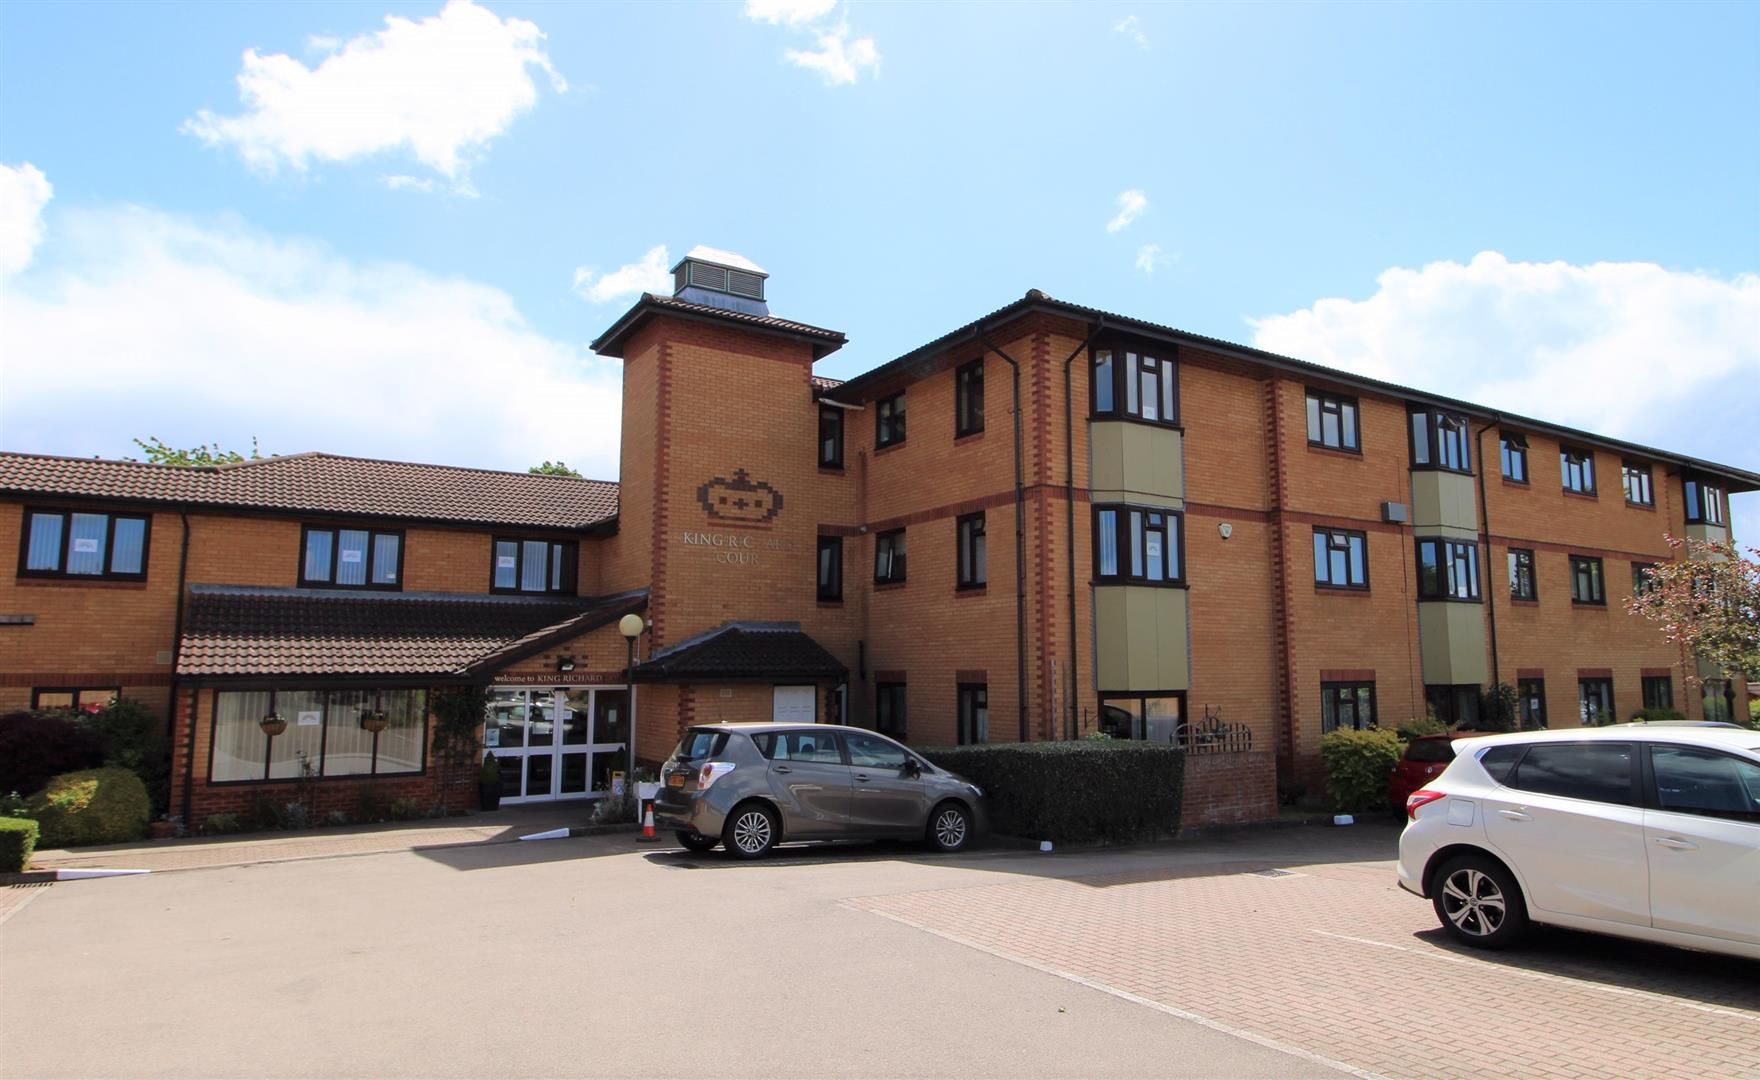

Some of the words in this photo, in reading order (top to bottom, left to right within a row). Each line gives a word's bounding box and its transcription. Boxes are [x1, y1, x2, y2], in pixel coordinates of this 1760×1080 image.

[683, 532, 723, 546] KING
[494, 674, 525, 682] welcome
[527, 674, 535, 682] to
[537, 674, 561, 682] KING
[563, 674, 602, 682] RICHARD
